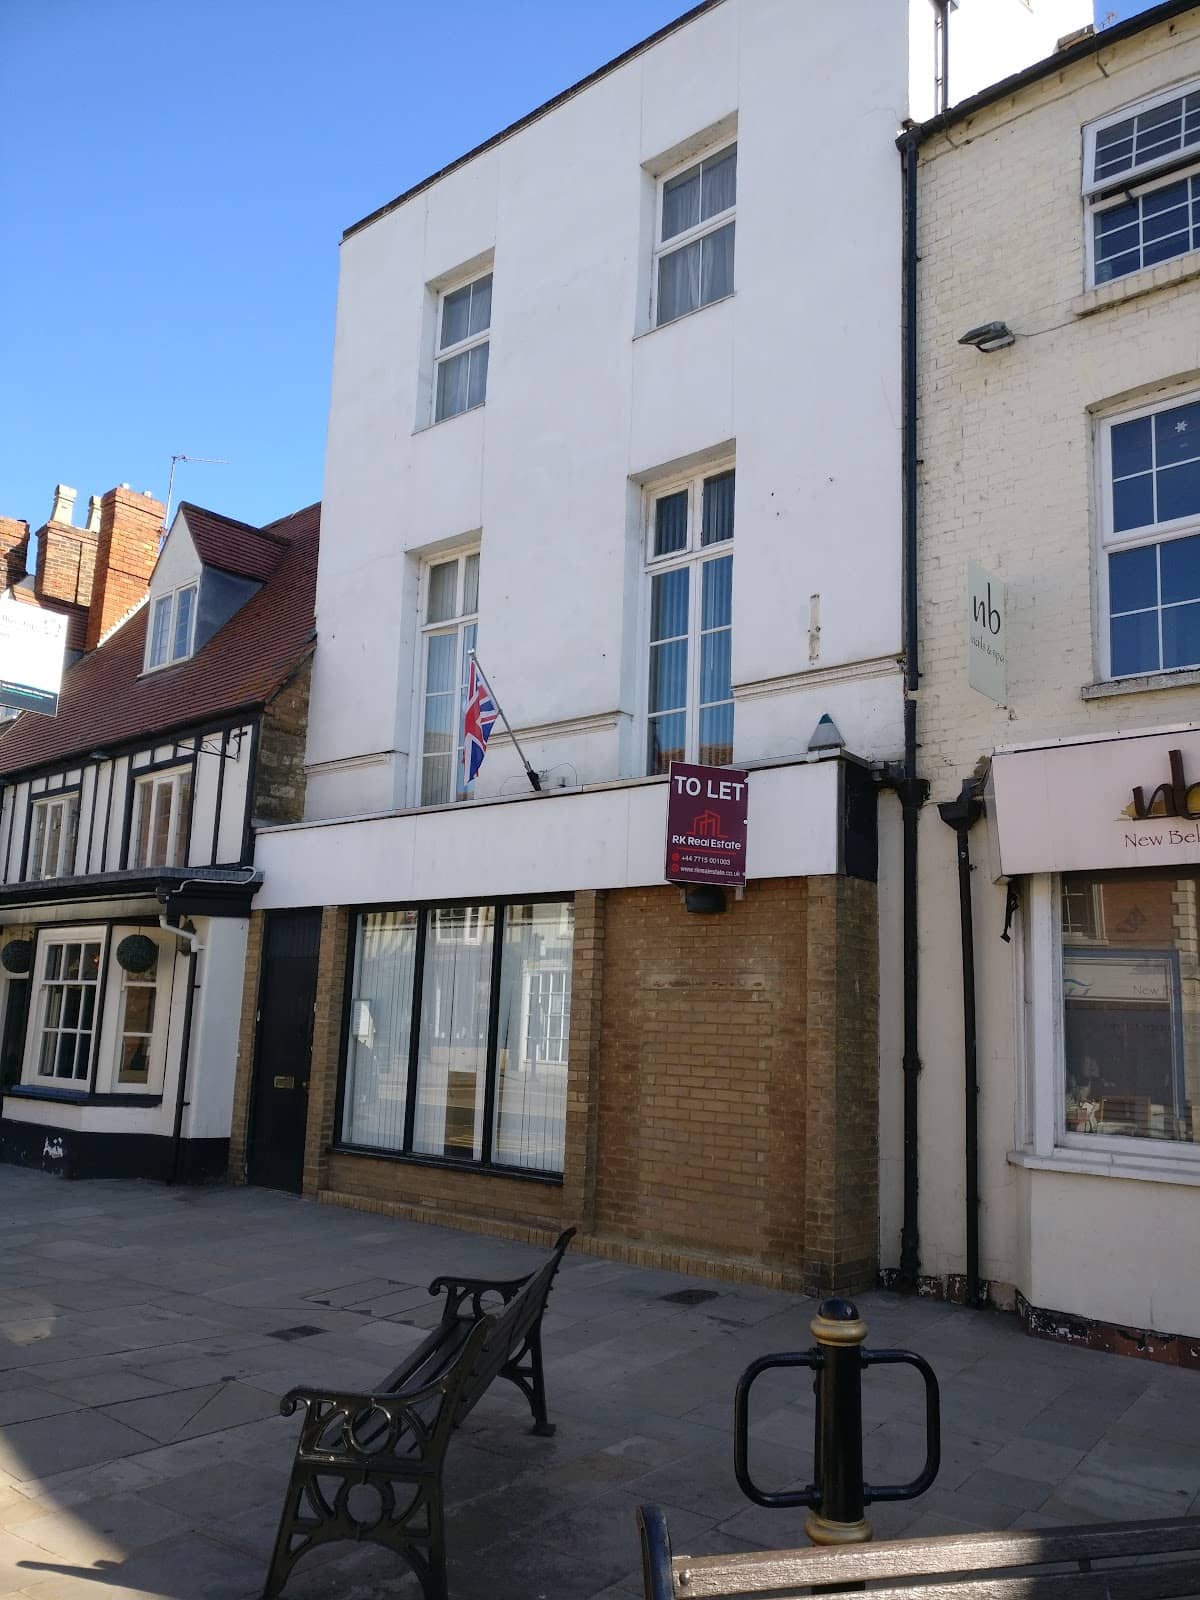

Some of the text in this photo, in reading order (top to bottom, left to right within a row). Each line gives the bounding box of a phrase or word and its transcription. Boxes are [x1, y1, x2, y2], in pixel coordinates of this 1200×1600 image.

[674, 775, 744, 801] TO LET
[672, 835, 741, 850] RK Real Estate
[1125, 832, 1163, 848] New
